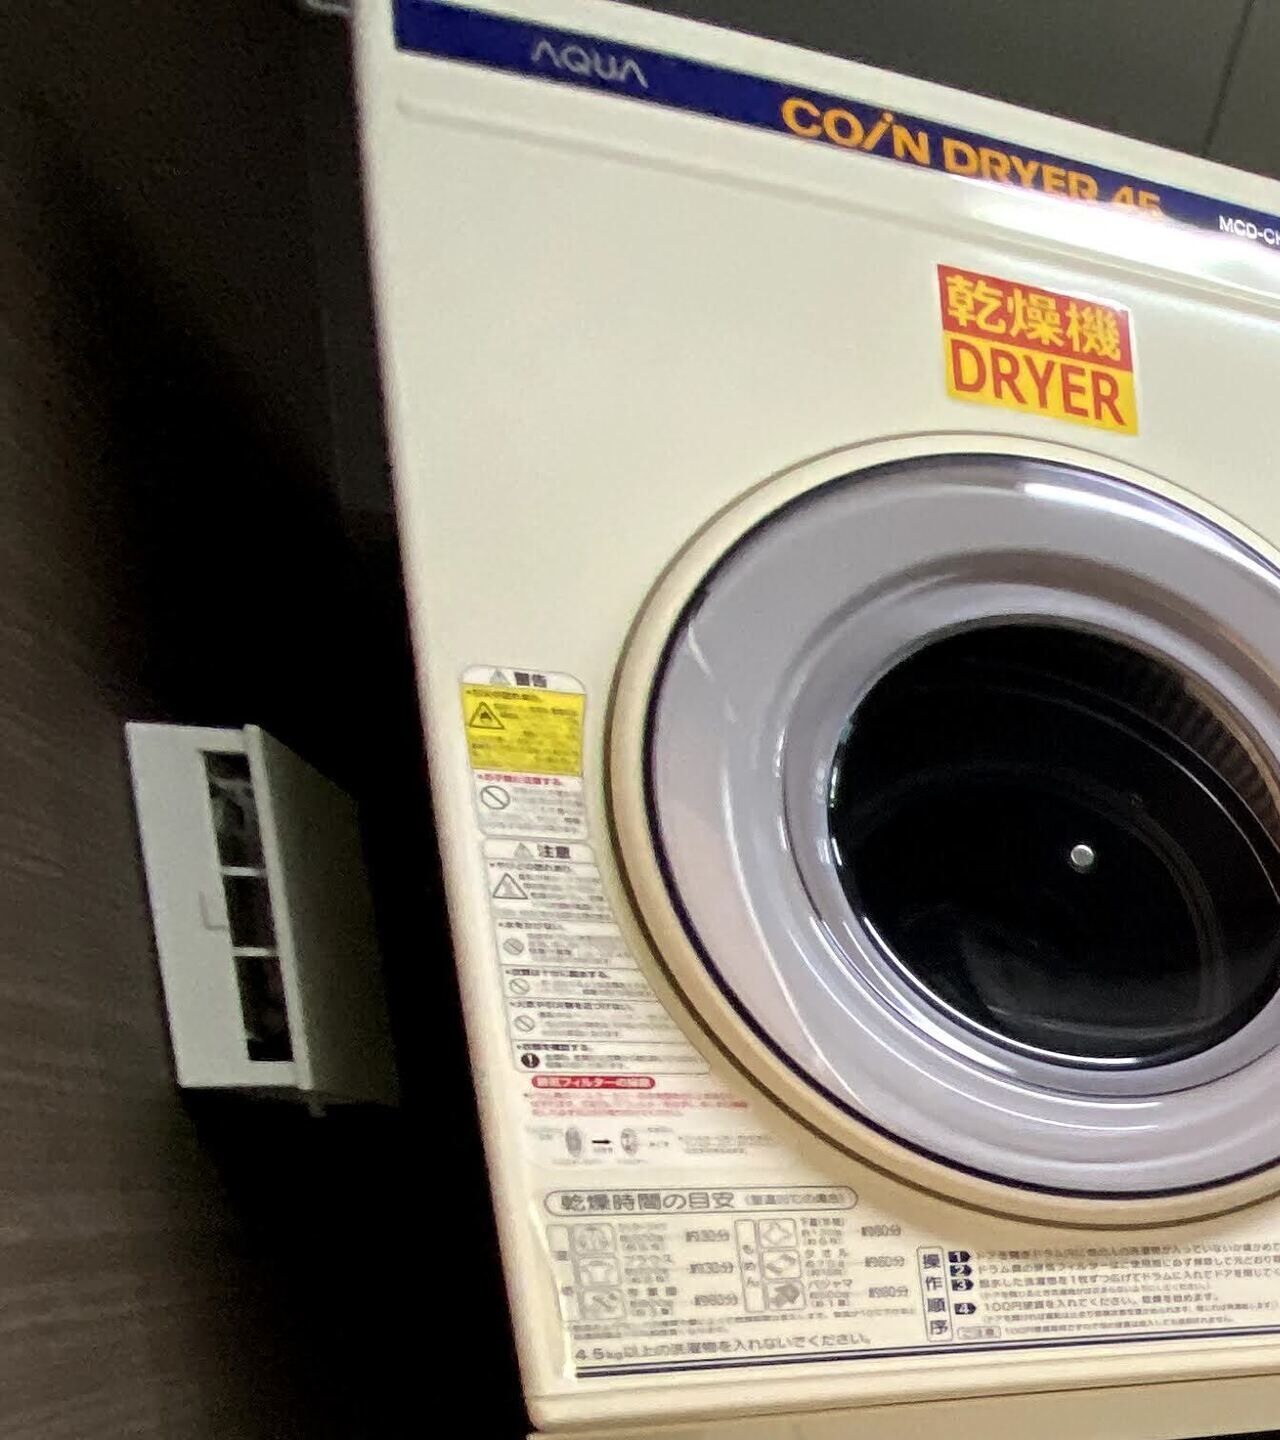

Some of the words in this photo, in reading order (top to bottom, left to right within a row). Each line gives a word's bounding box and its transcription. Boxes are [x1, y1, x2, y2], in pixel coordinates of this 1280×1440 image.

[530, 36, 649, 89] AQUA
[781, 96, 931, 167] COIN
[942, 137, 1098, 201] DRYER
[944, 274, 1122, 362] 乾燥機
[950, 340, 1127, 427] DRYER
